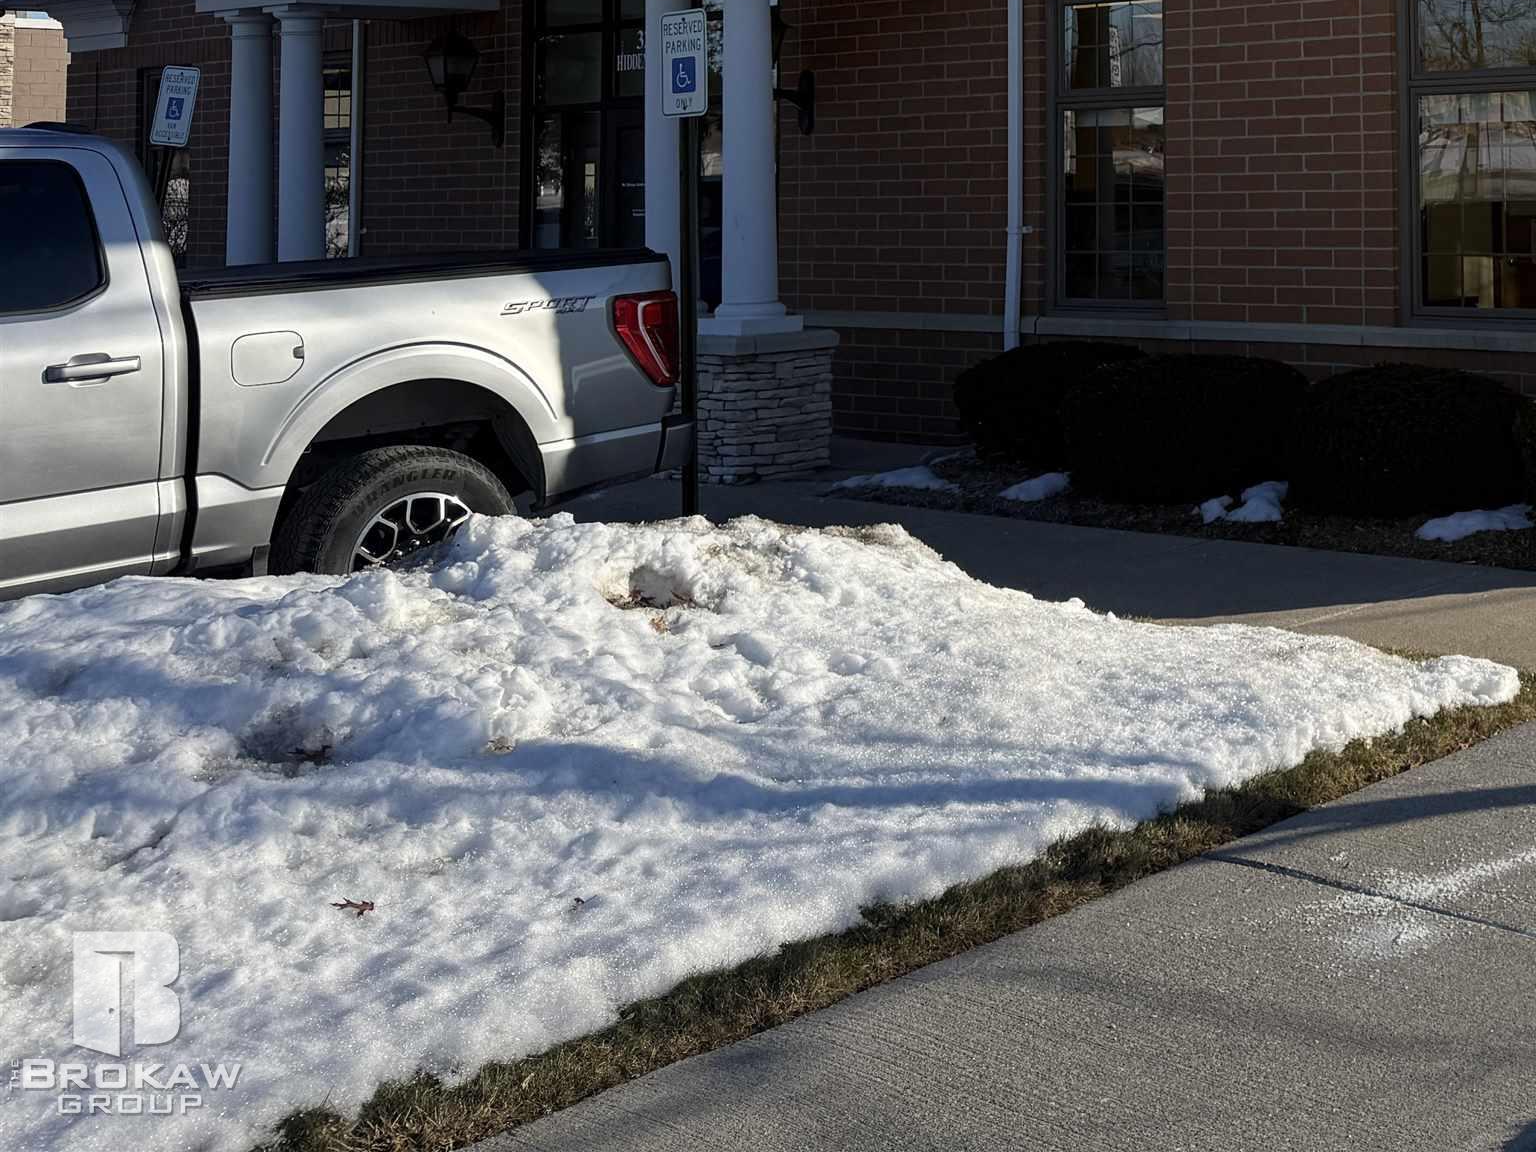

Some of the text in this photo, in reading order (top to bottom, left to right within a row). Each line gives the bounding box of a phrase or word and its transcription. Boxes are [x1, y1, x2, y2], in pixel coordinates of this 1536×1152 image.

[664, 19, 703, 36] RESERVED
[665, 38, 702, 54] PARKING
[616, 53, 646, 72] HIDDE
[167, 85, 192, 95] PARKING
[675, 97, 693, 110] ONLY
[500, 295, 597, 316] SPORT
